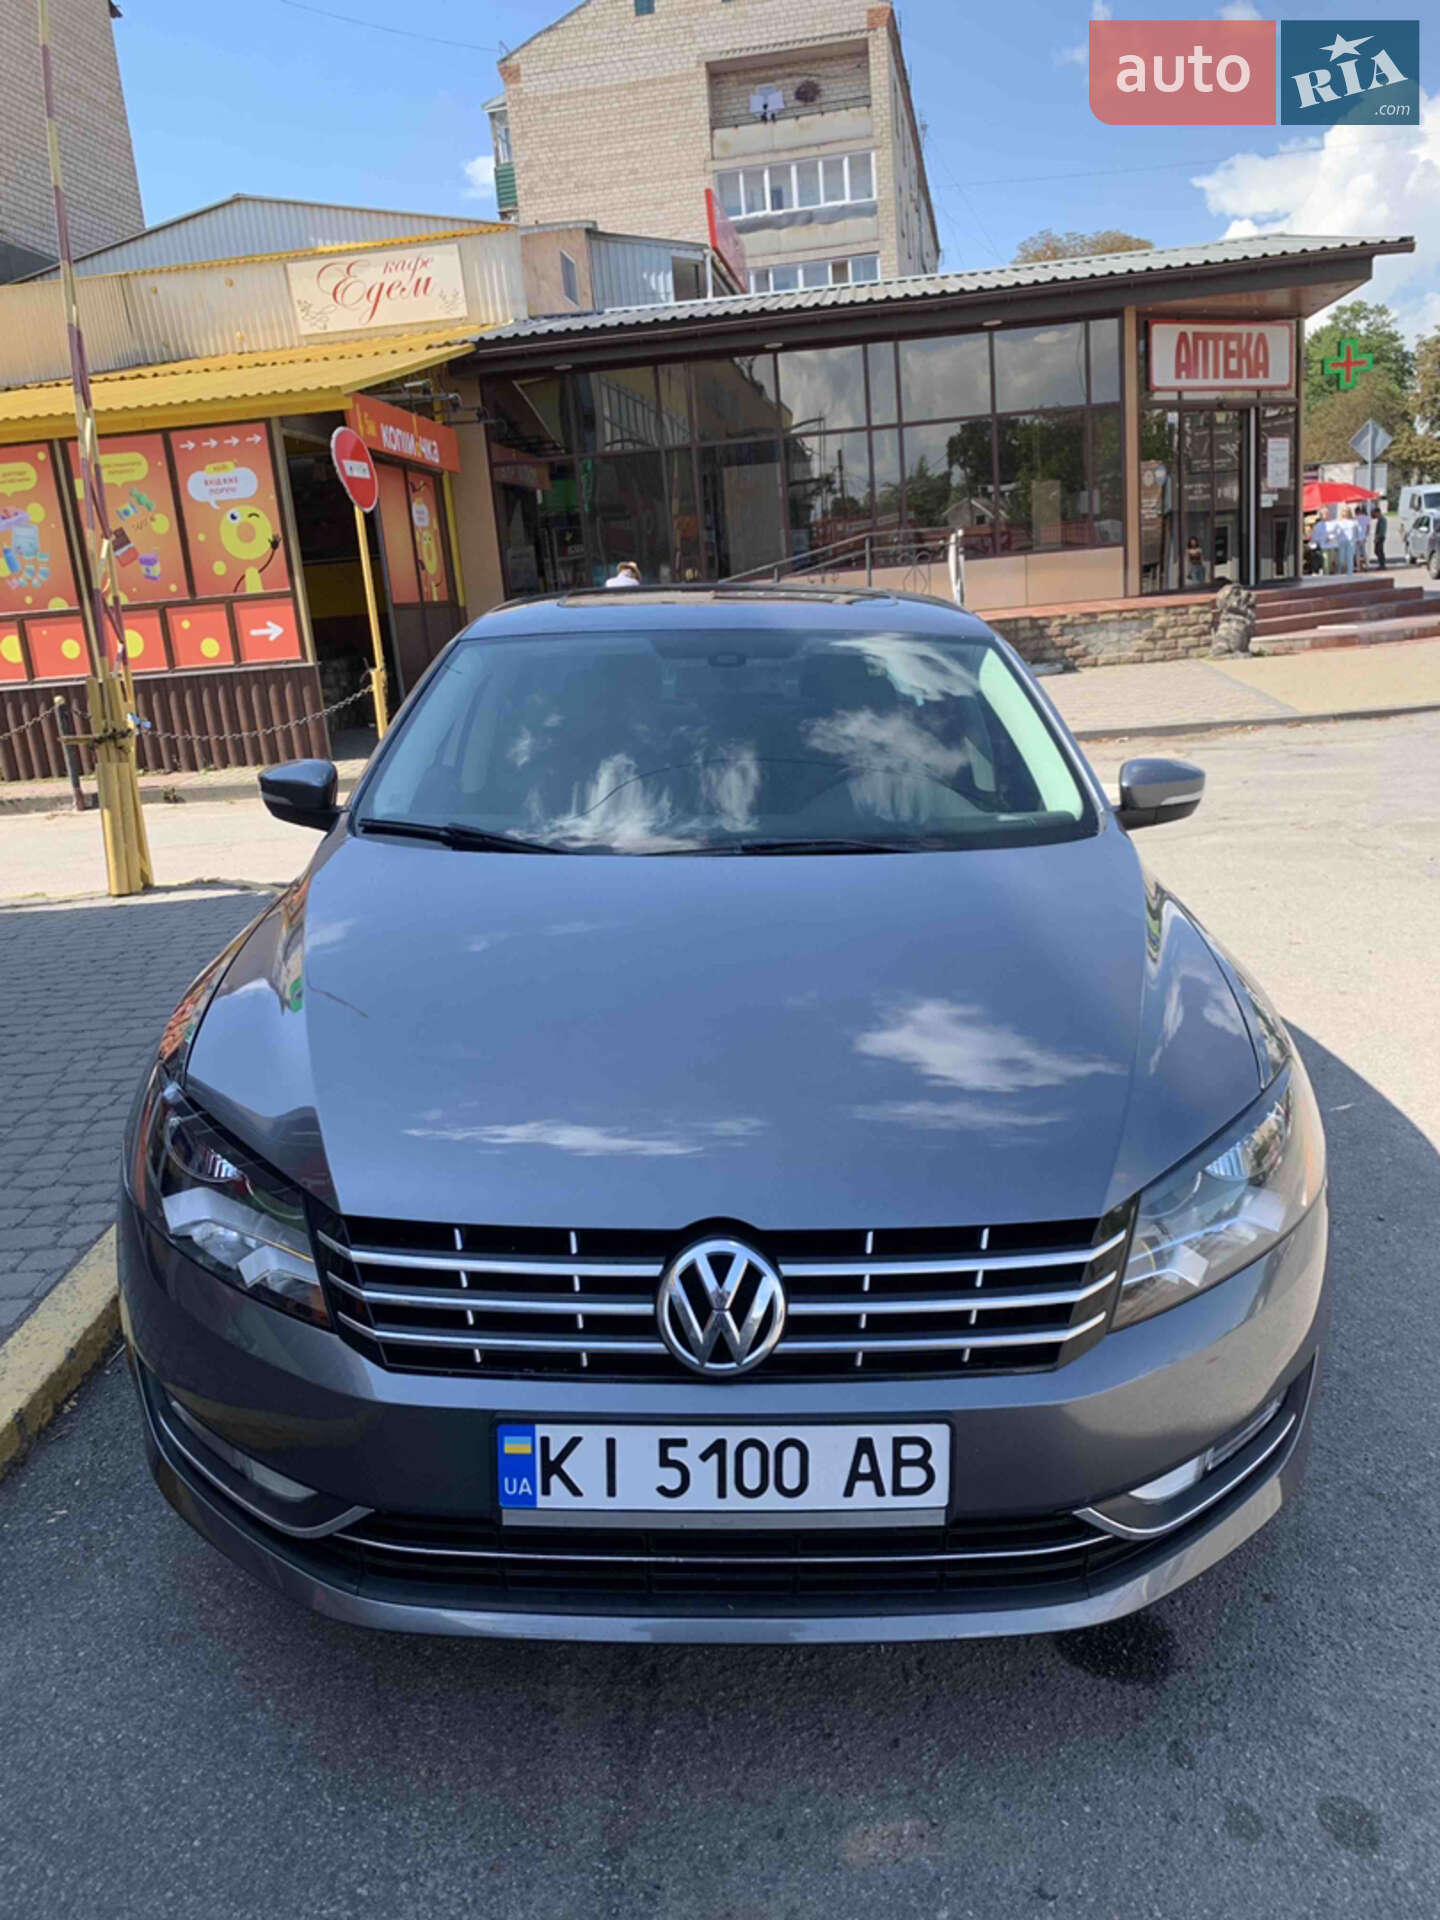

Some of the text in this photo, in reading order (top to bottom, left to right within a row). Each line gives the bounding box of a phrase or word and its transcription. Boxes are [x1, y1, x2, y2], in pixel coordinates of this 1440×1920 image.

[1174, 330, 1270, 380] АПТЕКА
[504, 1477, 532, 1496] UA
[655, 1437, 810, 1499] 5100
[842, 1435, 937, 1498] AB
